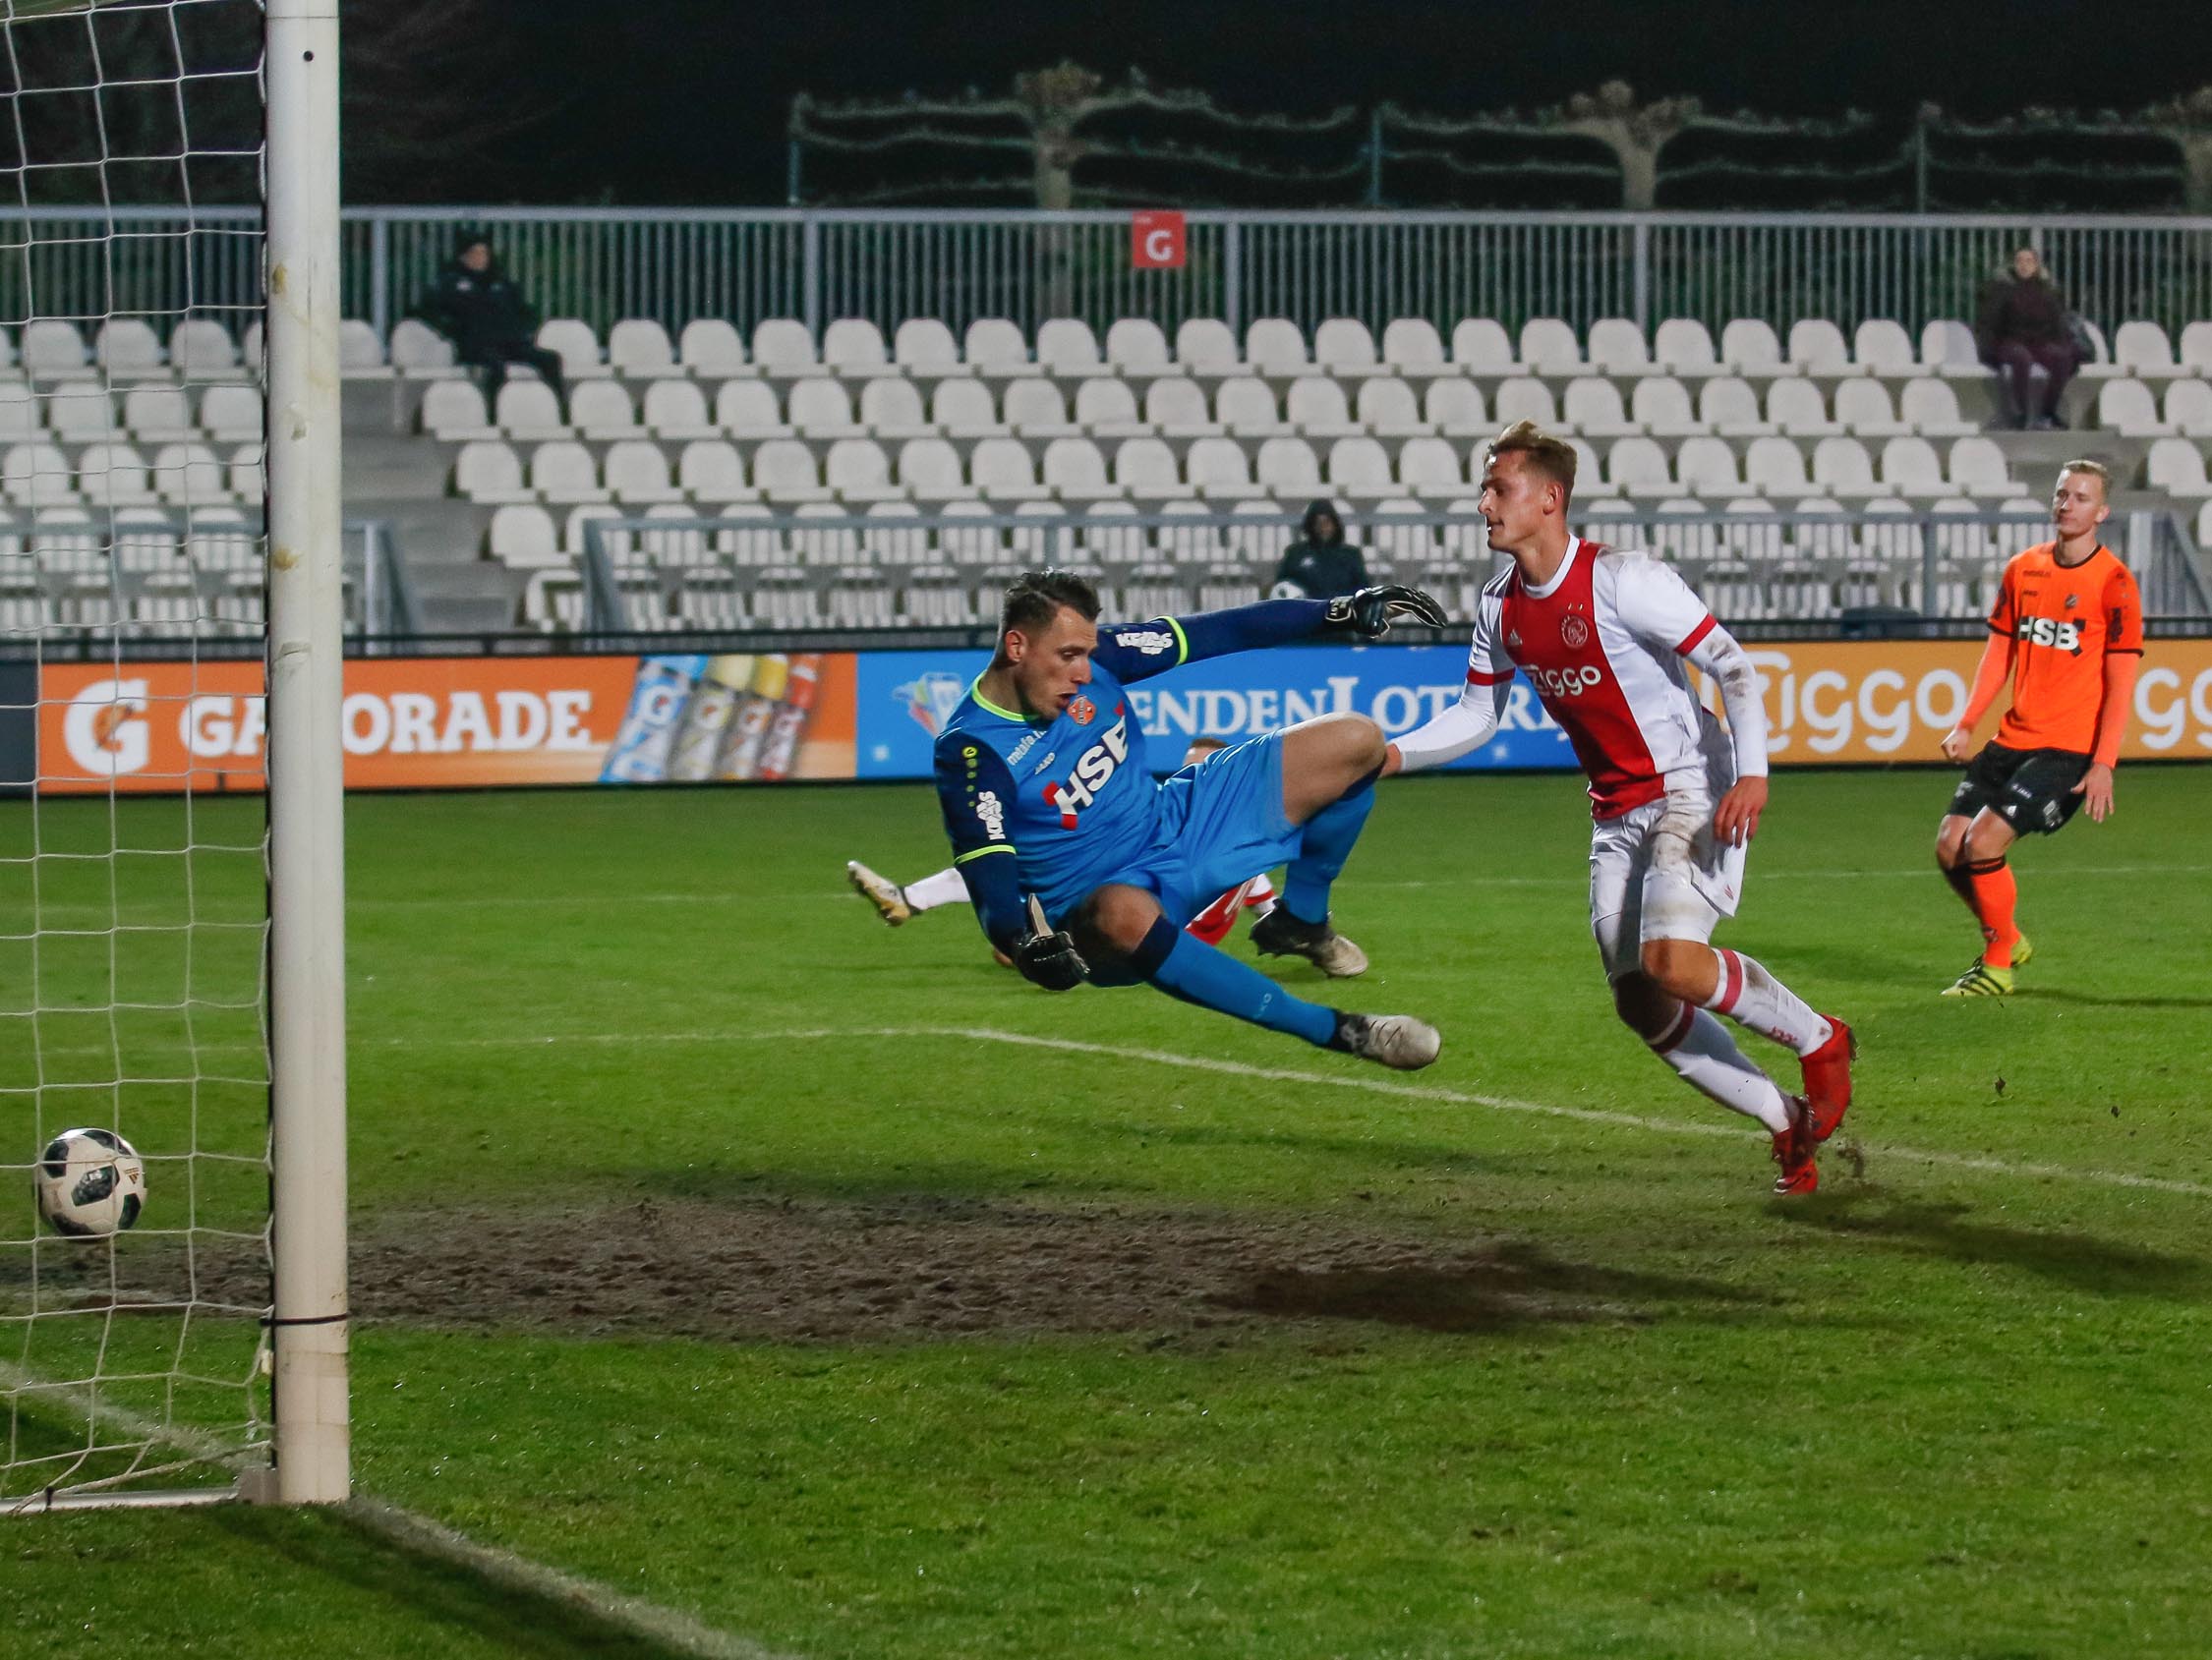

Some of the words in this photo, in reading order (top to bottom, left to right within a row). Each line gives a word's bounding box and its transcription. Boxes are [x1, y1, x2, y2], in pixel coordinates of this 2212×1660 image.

[1145, 230, 1174, 261] G
[2018, 616, 2079, 651] HSB
[64, 678, 149, 774] G
[179, 690, 592, 757] GAORADE
